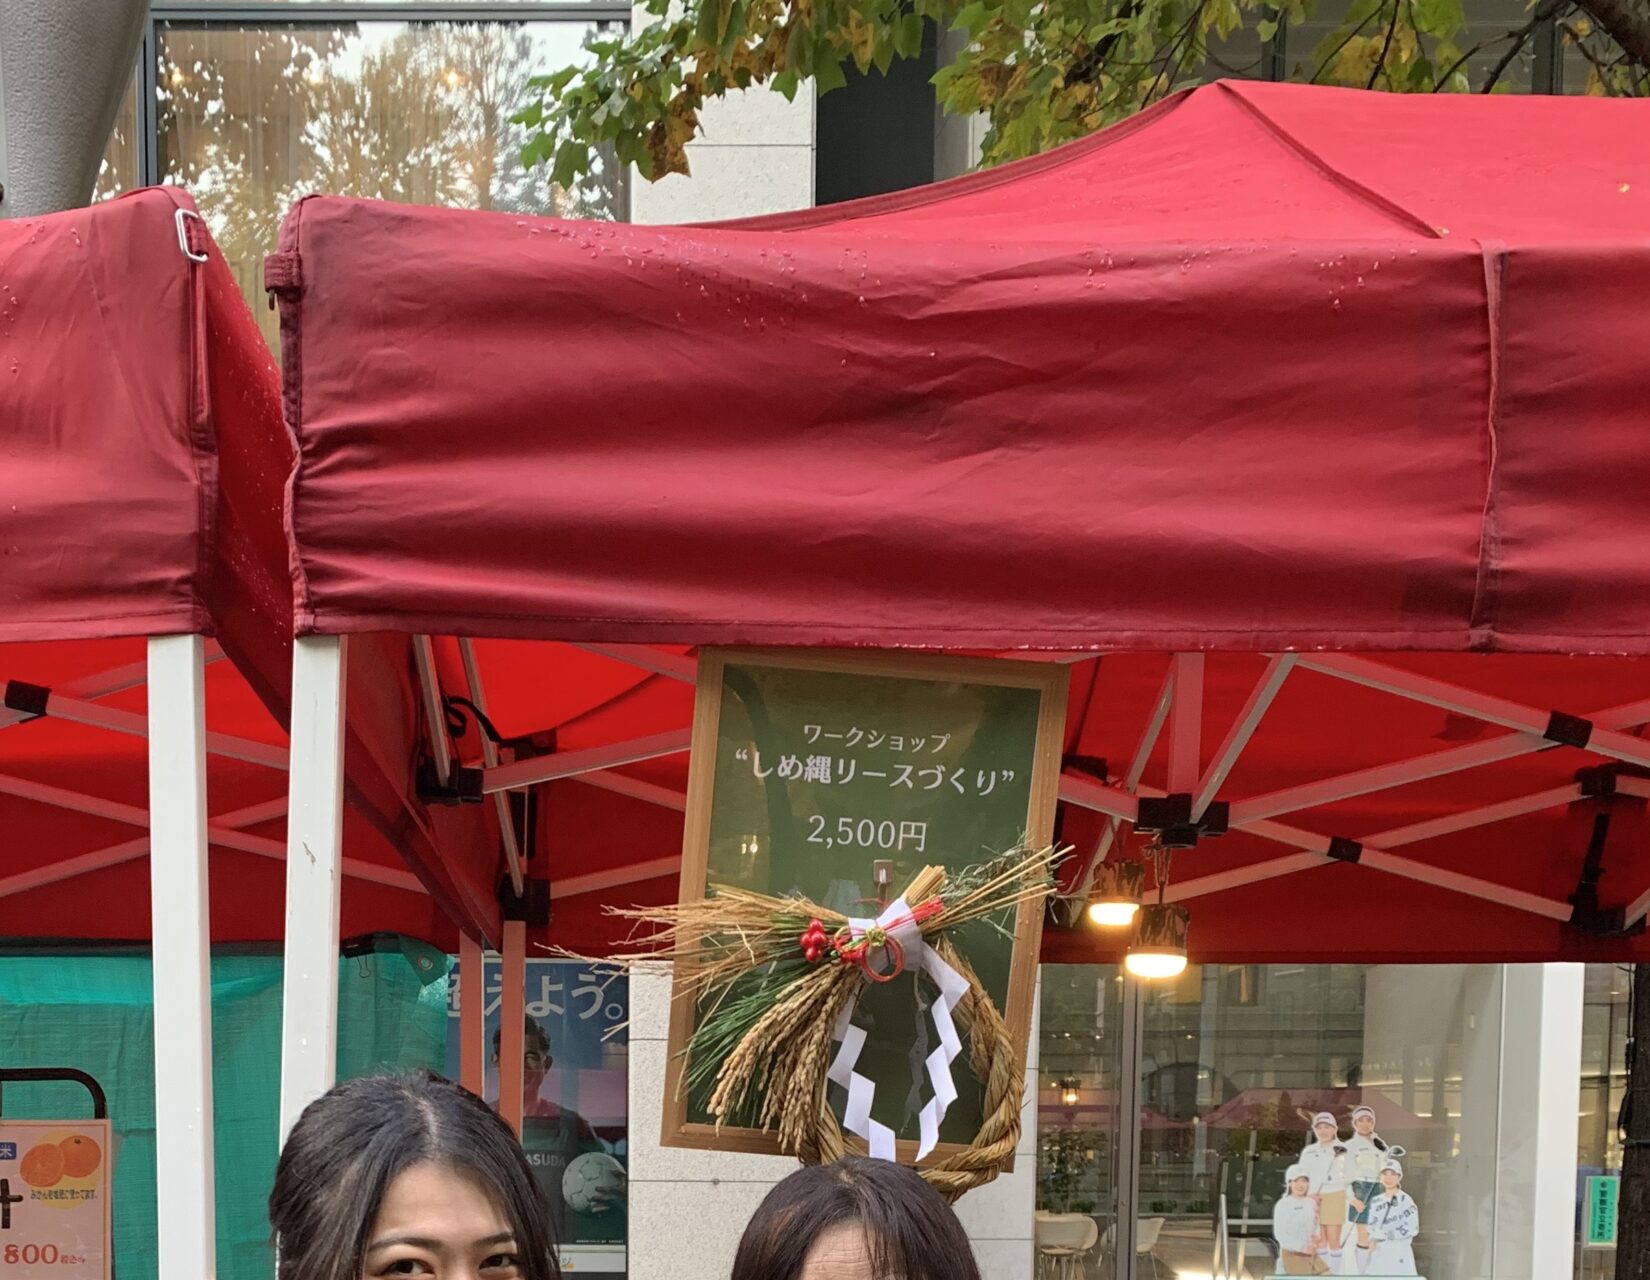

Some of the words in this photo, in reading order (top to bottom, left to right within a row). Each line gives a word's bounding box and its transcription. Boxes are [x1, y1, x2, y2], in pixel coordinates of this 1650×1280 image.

[803, 724, 952, 754] ワークショップ
[806, 814, 928, 852] 2,500円
[3, 1243, 59, 1265] 800
